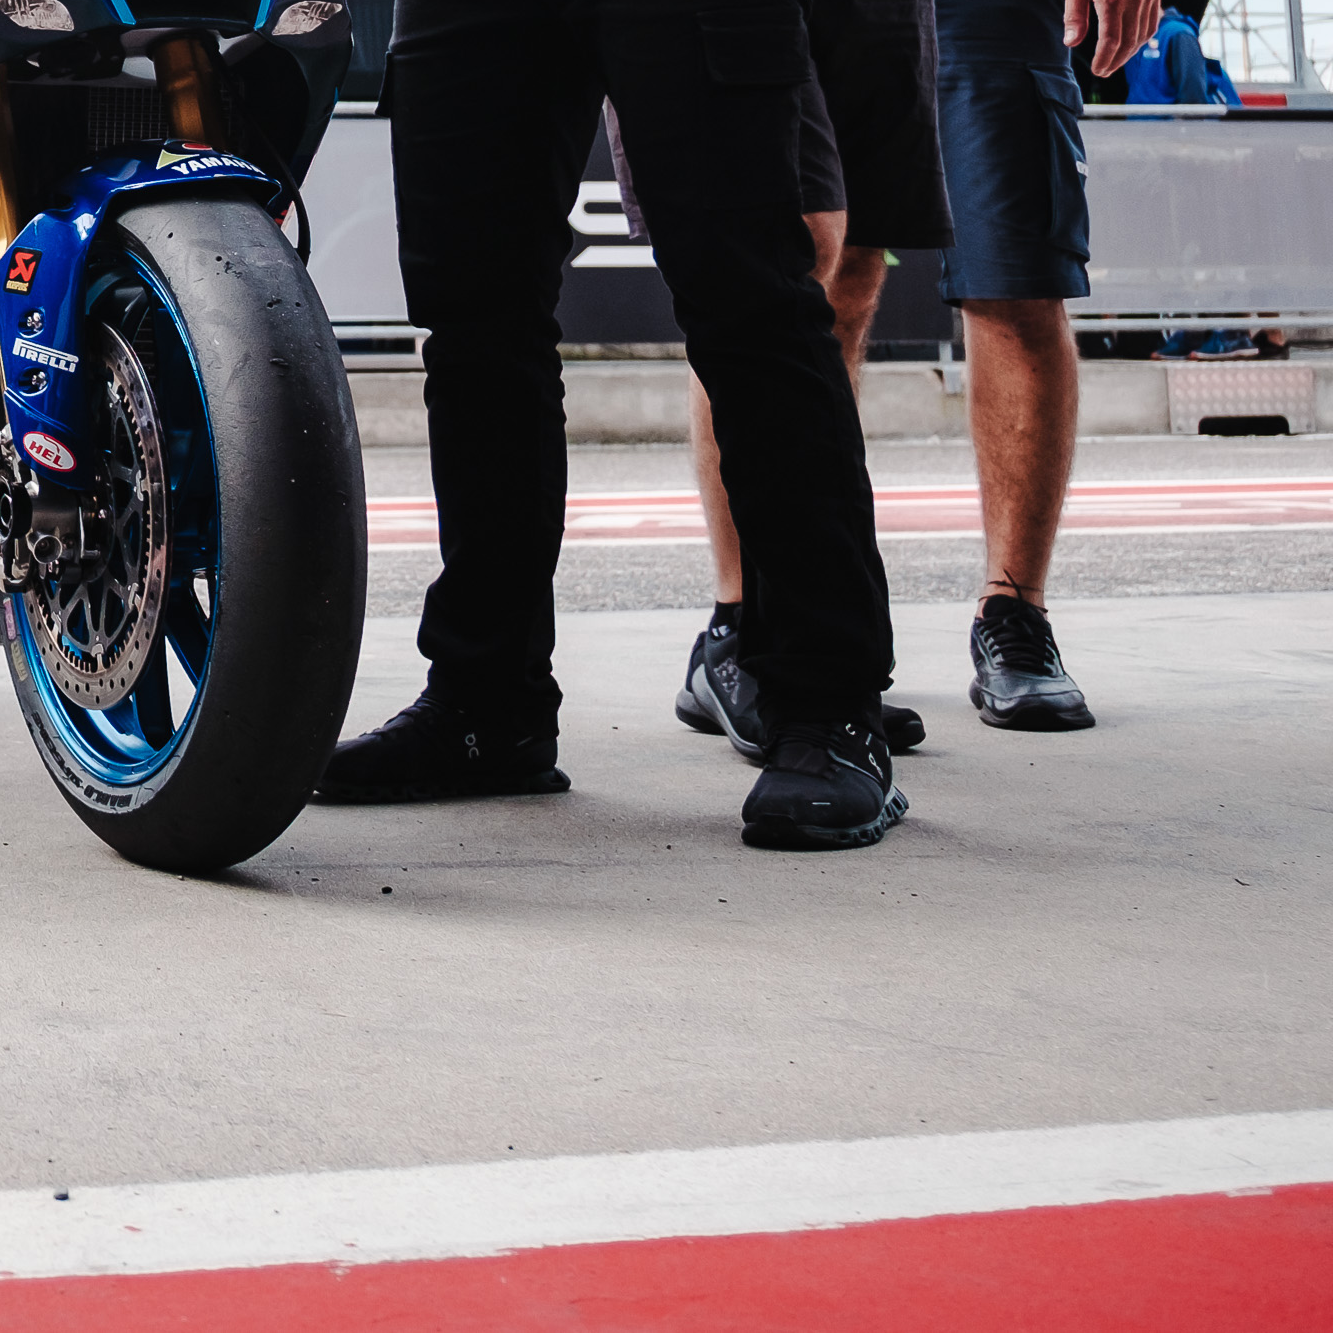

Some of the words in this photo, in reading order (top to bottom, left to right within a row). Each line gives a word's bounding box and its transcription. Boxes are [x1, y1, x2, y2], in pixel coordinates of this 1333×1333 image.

[170, 156, 267, 176] YAMAHA
[11, 336, 80, 374] PIRELLI
[29, 440, 65, 470] HEL
